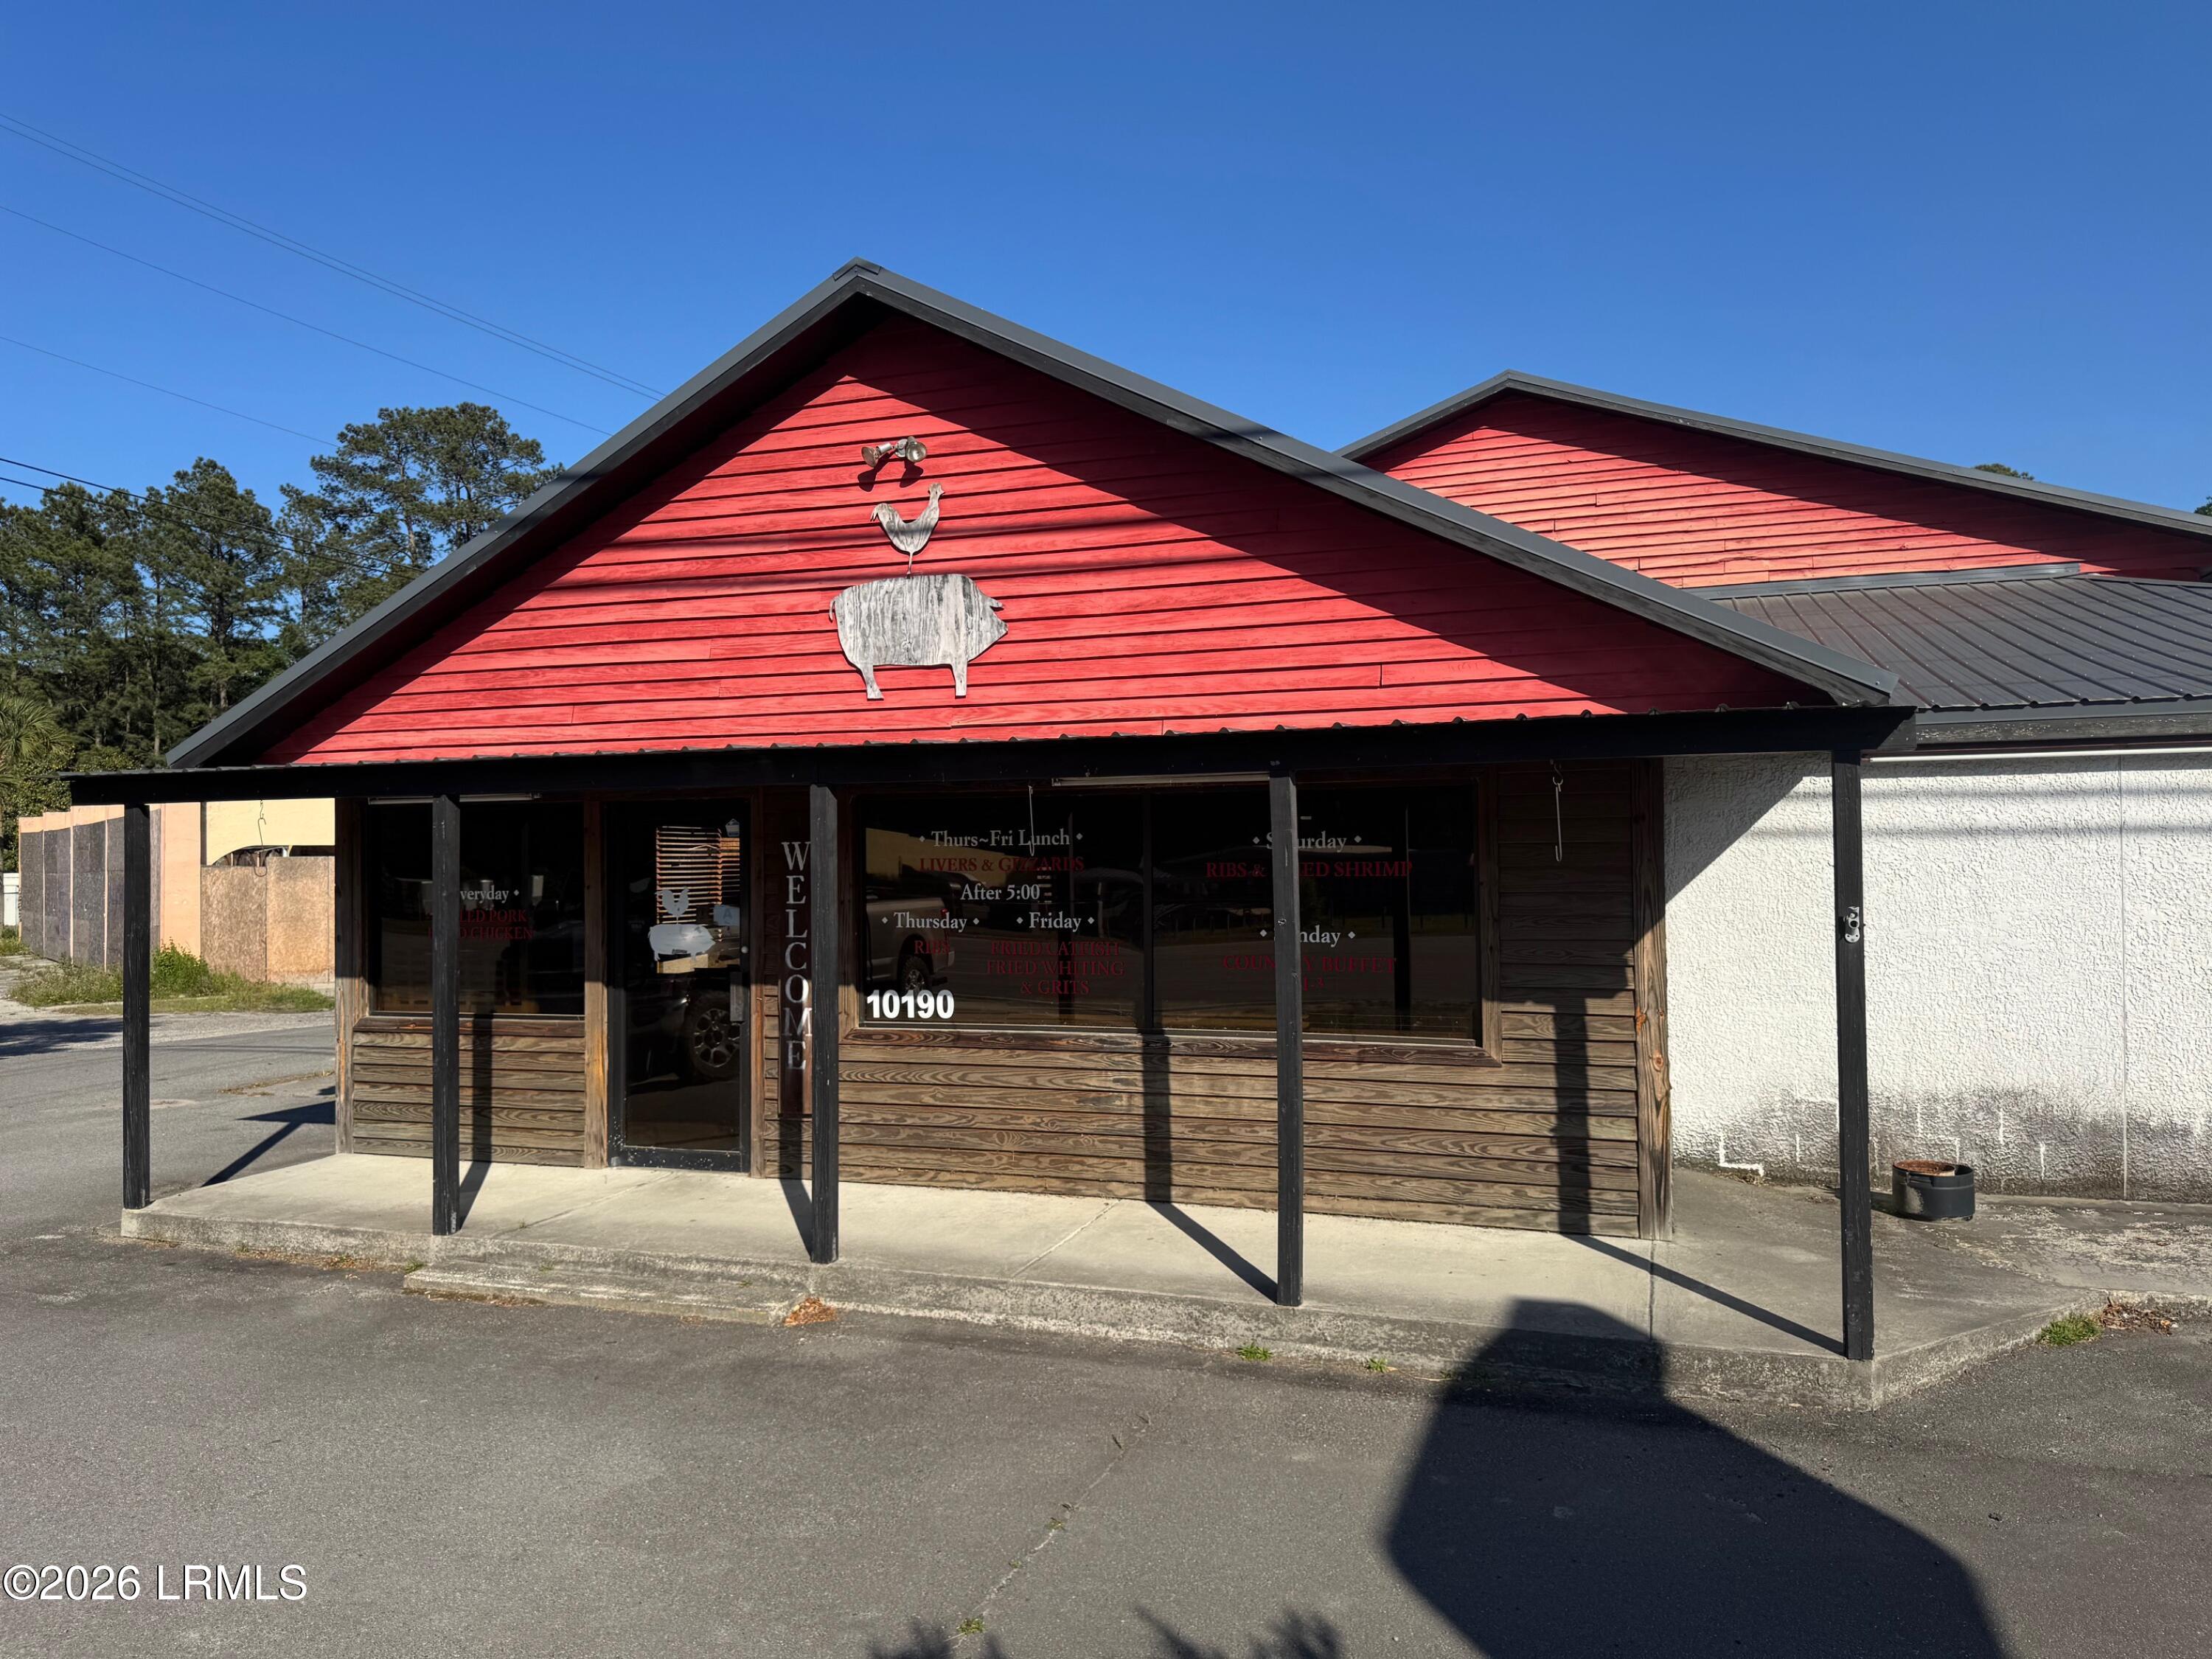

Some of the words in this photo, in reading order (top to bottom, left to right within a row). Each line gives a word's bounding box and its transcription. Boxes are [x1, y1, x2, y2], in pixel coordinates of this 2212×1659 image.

[931, 830, 1014, 847] Thurs~Fri
[1018, 828, 1071, 846] Lunch
[1266, 830, 1348, 853] Surday
[919, 857, 977, 872] LIVERS
[981, 859, 994, 872] &
[998, 855, 1085, 873] GIZZARDS
[1205, 860, 1248, 878] RIBS
[1251, 861, 1269, 878] &
[1332, 860, 1413, 878] SHRIMP
[459, 884, 509, 904] veryday
[959, 883, 1002, 901] After
[1006, 883, 1040, 901] 5:00
[490, 908, 529, 922] PORK
[893, 911, 968, 933] Thursday
[1029, 911, 1082, 933] Friday
[471, 926, 534, 939] CHICKEN
[1274, 925, 1342, 948] nday
[781, 841, 813, 1071] WELCOME
[914, 939, 950, 955] RIBS
[991, 941, 1042, 956] FRIED
[1046, 940, 1120, 956] CATFISH
[987, 960, 1038, 975] FRIED
[1040, 960, 1127, 977] WHITING
[1223, 955, 1317, 973] COUNY
[1321, 956, 1398, 974] BUFFET
[1020, 981, 1034, 995] &
[1037, 979, 1091, 995] GRITS
[866, 989, 955, 1019] 10190
